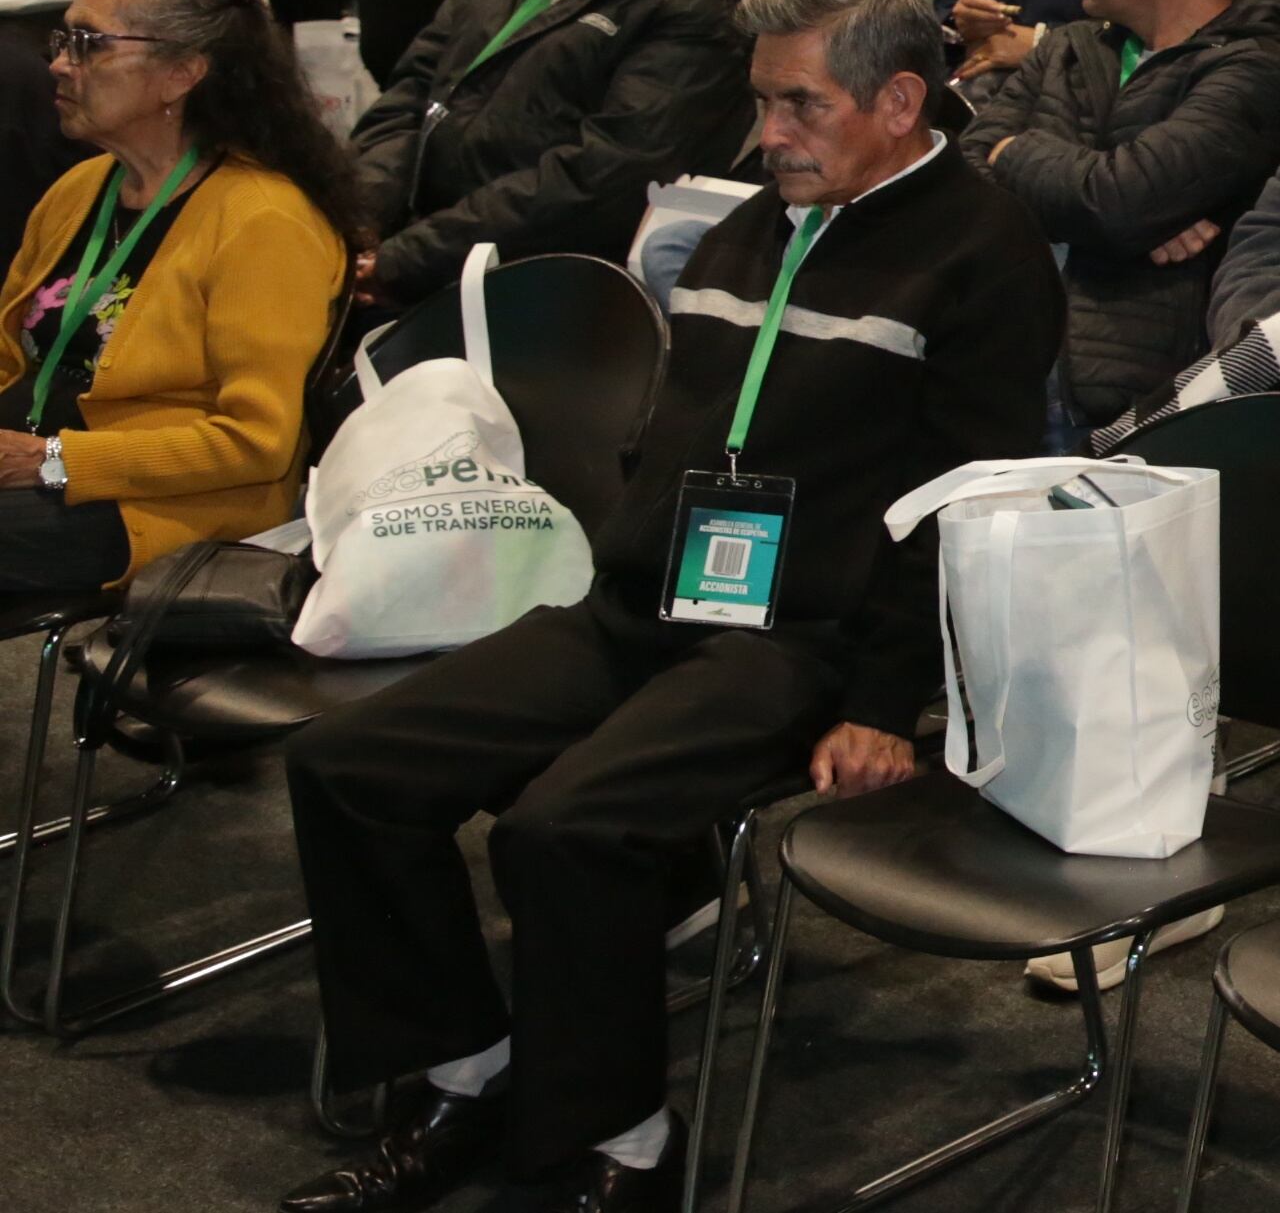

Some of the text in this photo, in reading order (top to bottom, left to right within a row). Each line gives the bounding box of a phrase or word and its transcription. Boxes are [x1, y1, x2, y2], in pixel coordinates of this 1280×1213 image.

[371, 499, 553, 525] SOMOS ENERGÍA
[373, 516, 554, 538] QUE TRANSFORMA
[699, 581, 748, 595] ACCIONISTA
